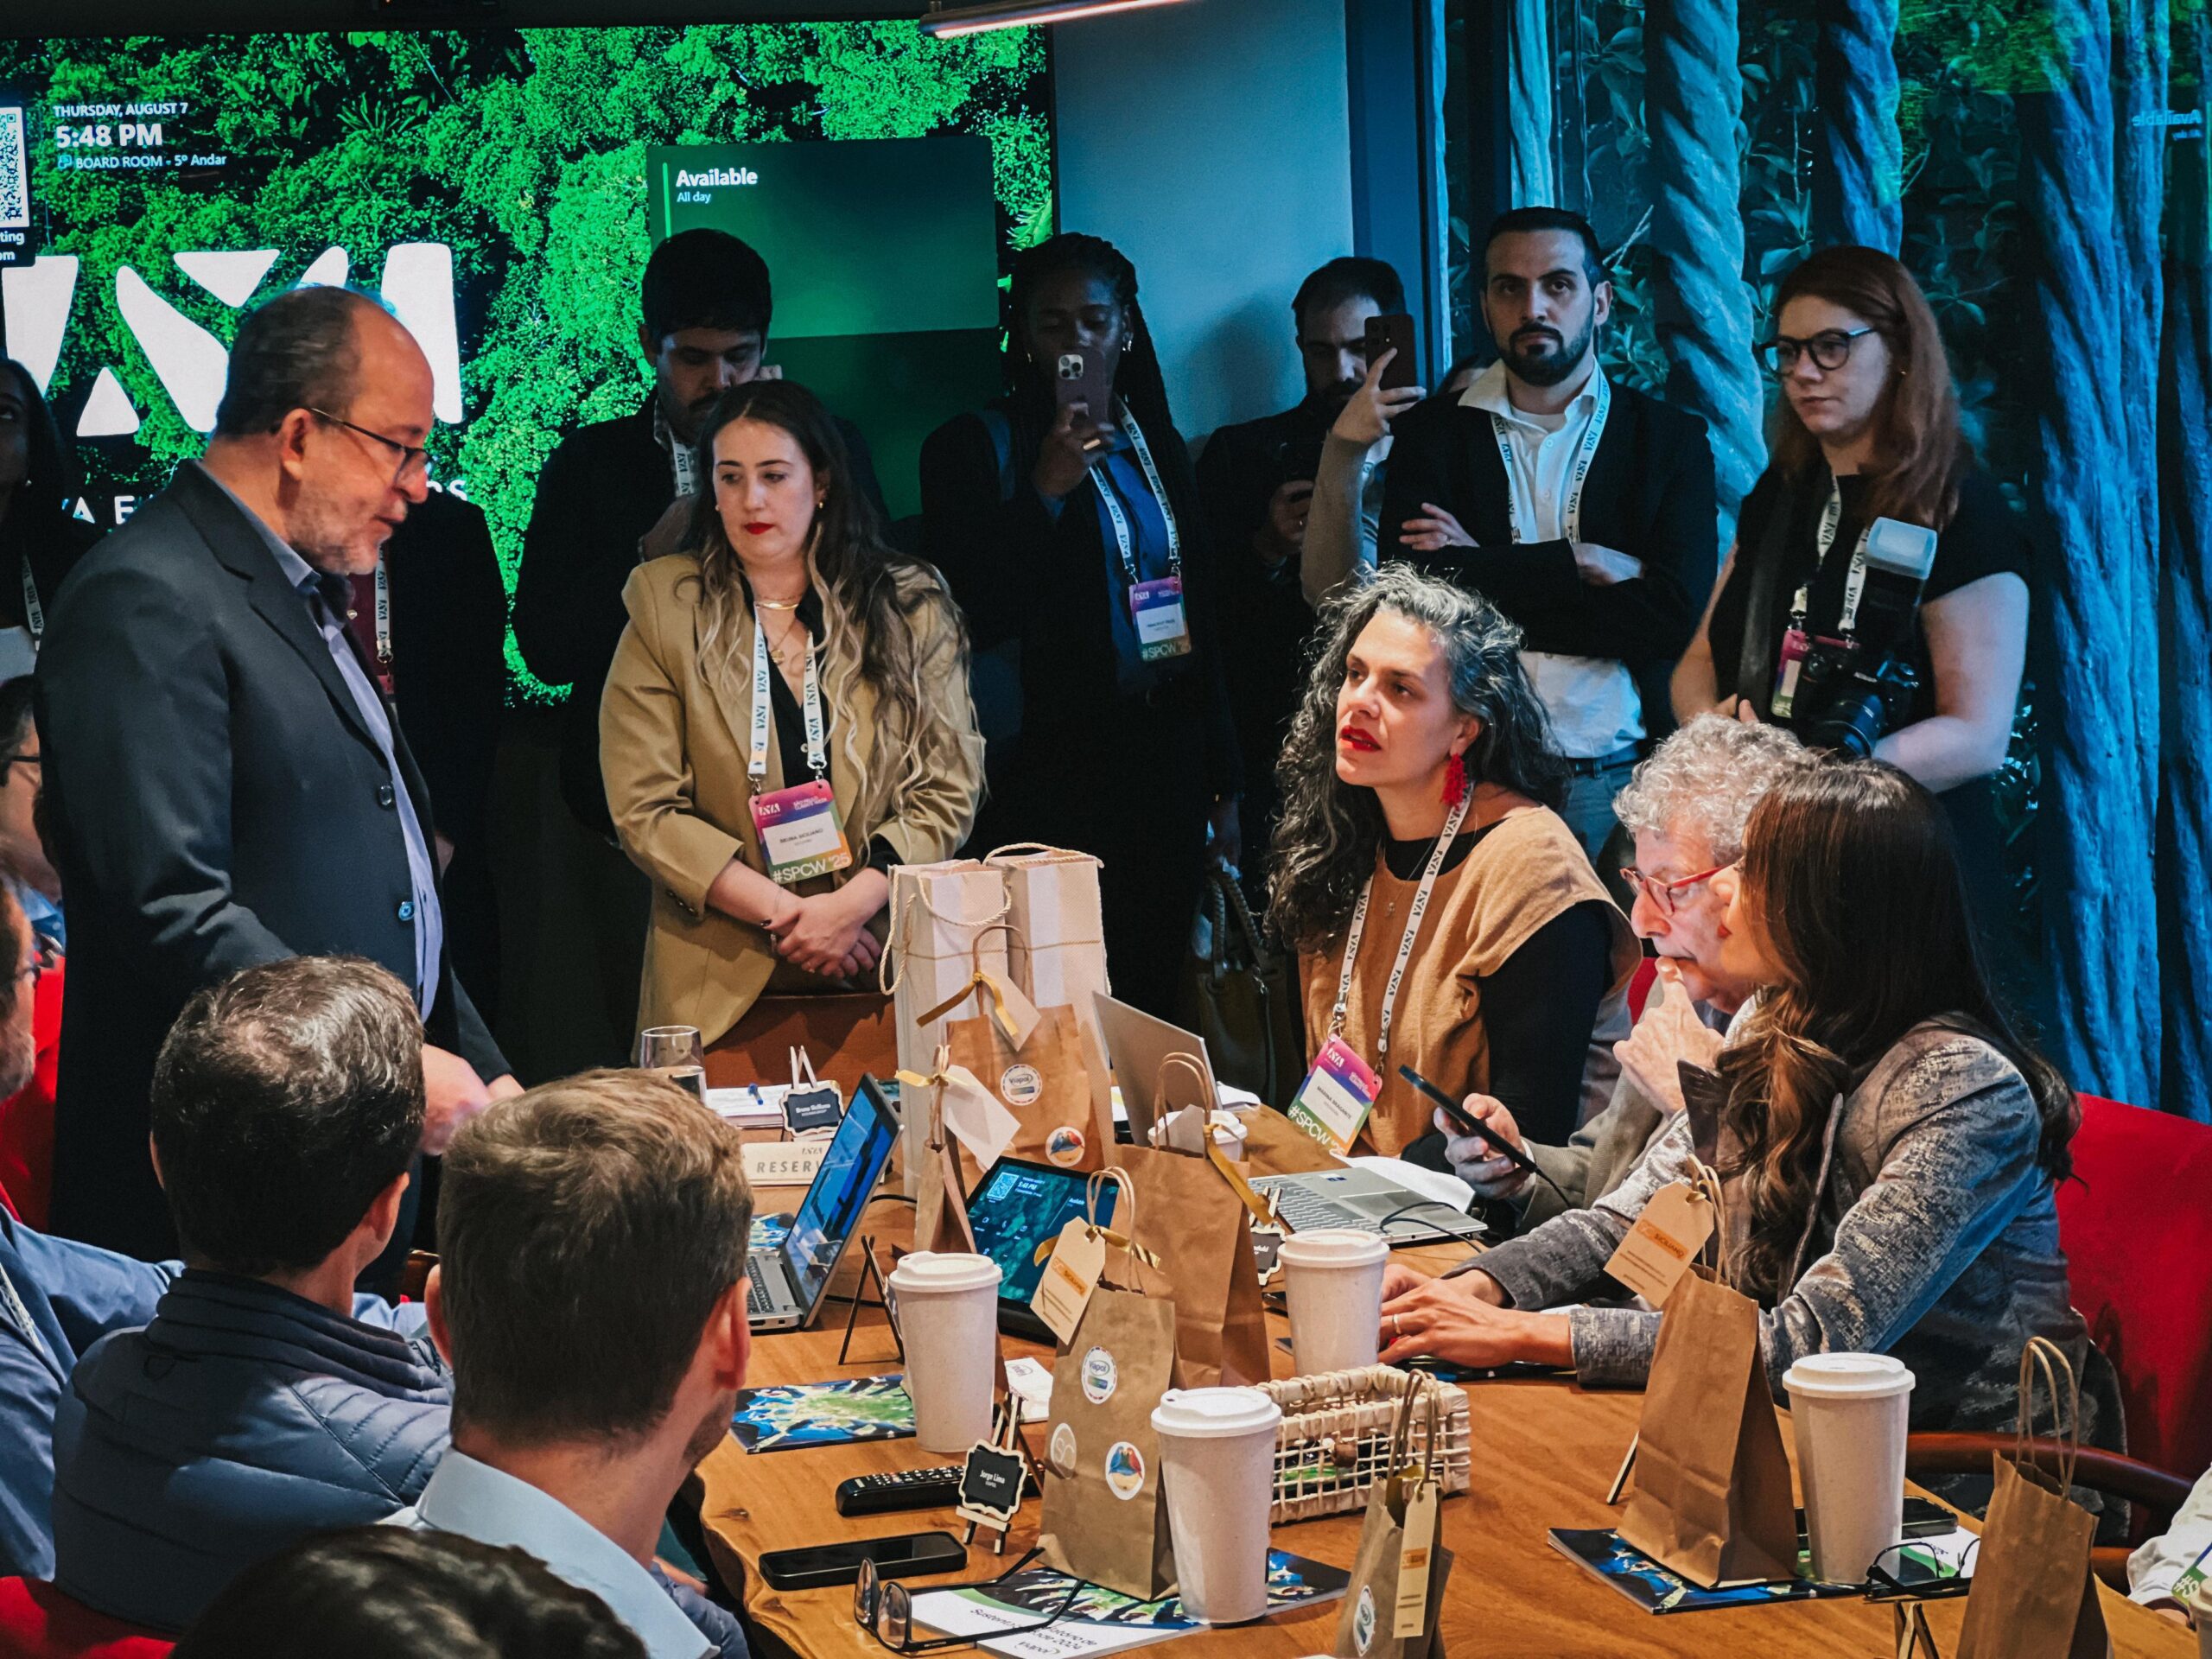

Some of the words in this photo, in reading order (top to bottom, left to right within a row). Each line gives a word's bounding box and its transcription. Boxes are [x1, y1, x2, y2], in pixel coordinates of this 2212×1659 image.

[54, 104, 124, 118] THURSDAY,
[125, 102, 176, 116] AUGUST
[180, 102, 188, 114] 7
[56, 124, 112, 149] 5:48
[119, 124, 162, 147] PM
[76, 156, 119, 168] BOARD
[123, 156, 162, 168] ROOM
[190, 153, 227, 166] Andar
[676, 167, 759, 188] Available
[677, 191, 690, 202] All
[692, 191, 711, 204] day
[773, 858, 826, 883] #SPCW
[828, 854, 850, 869] '25
[1288, 1105, 1332, 1145] #SPCW
[979, 1469, 993, 1481] Jorge
[993, 1473, 1006, 1484] Lima
